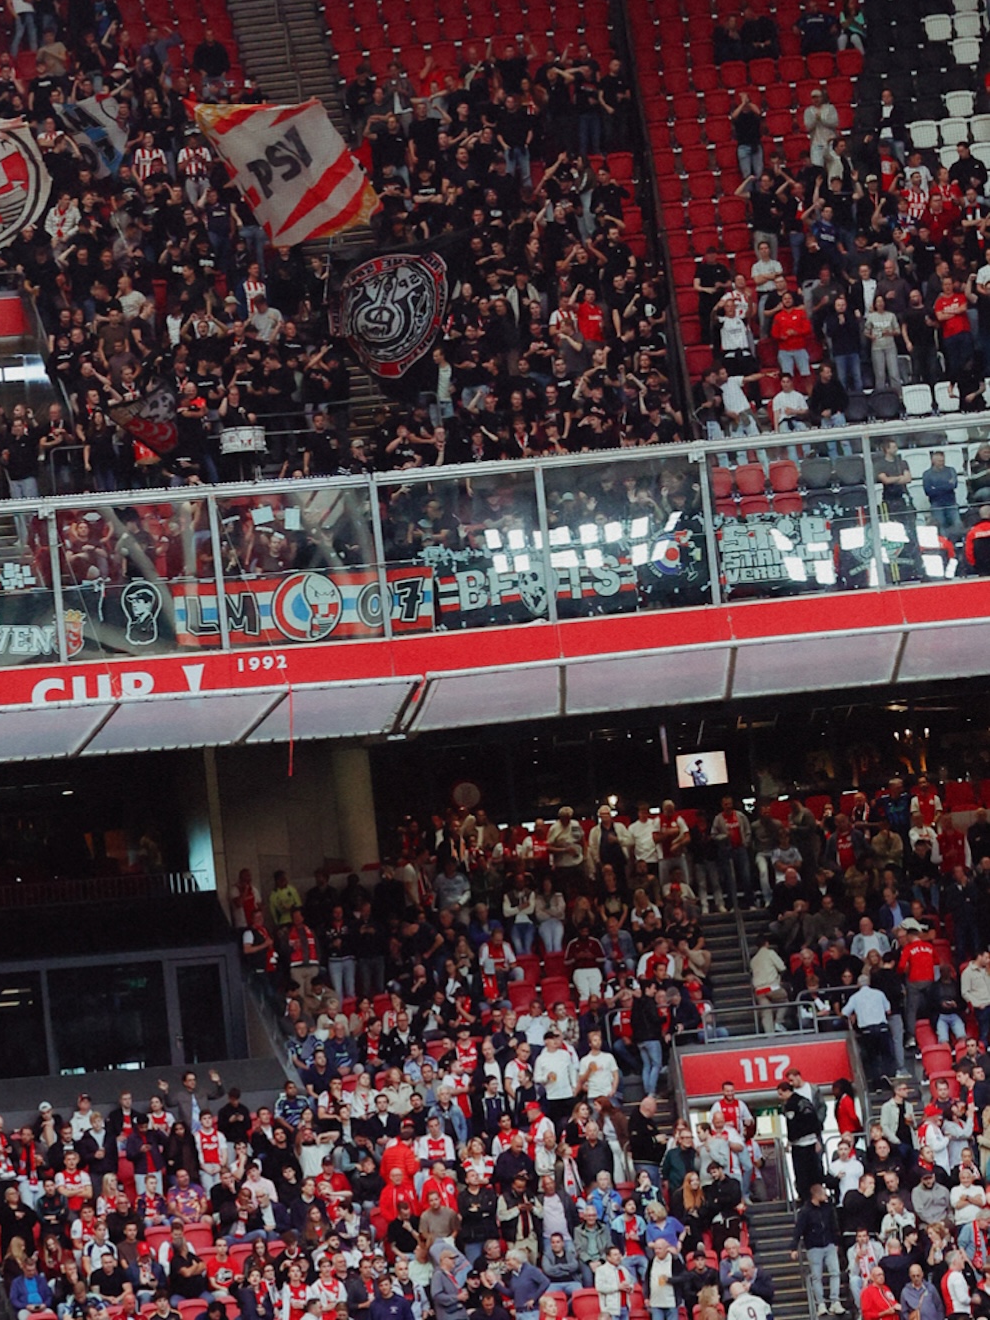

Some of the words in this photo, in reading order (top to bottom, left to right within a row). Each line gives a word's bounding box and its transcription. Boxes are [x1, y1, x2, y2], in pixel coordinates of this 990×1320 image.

[247, 125, 313, 199] PSV
[184, 591, 260, 636] LM
[356, 577, 424, 628] 07
[237, 655, 288, 672] 1992
[31, 672, 155, 704] CUP
[740, 1054, 791, 1083] 117
